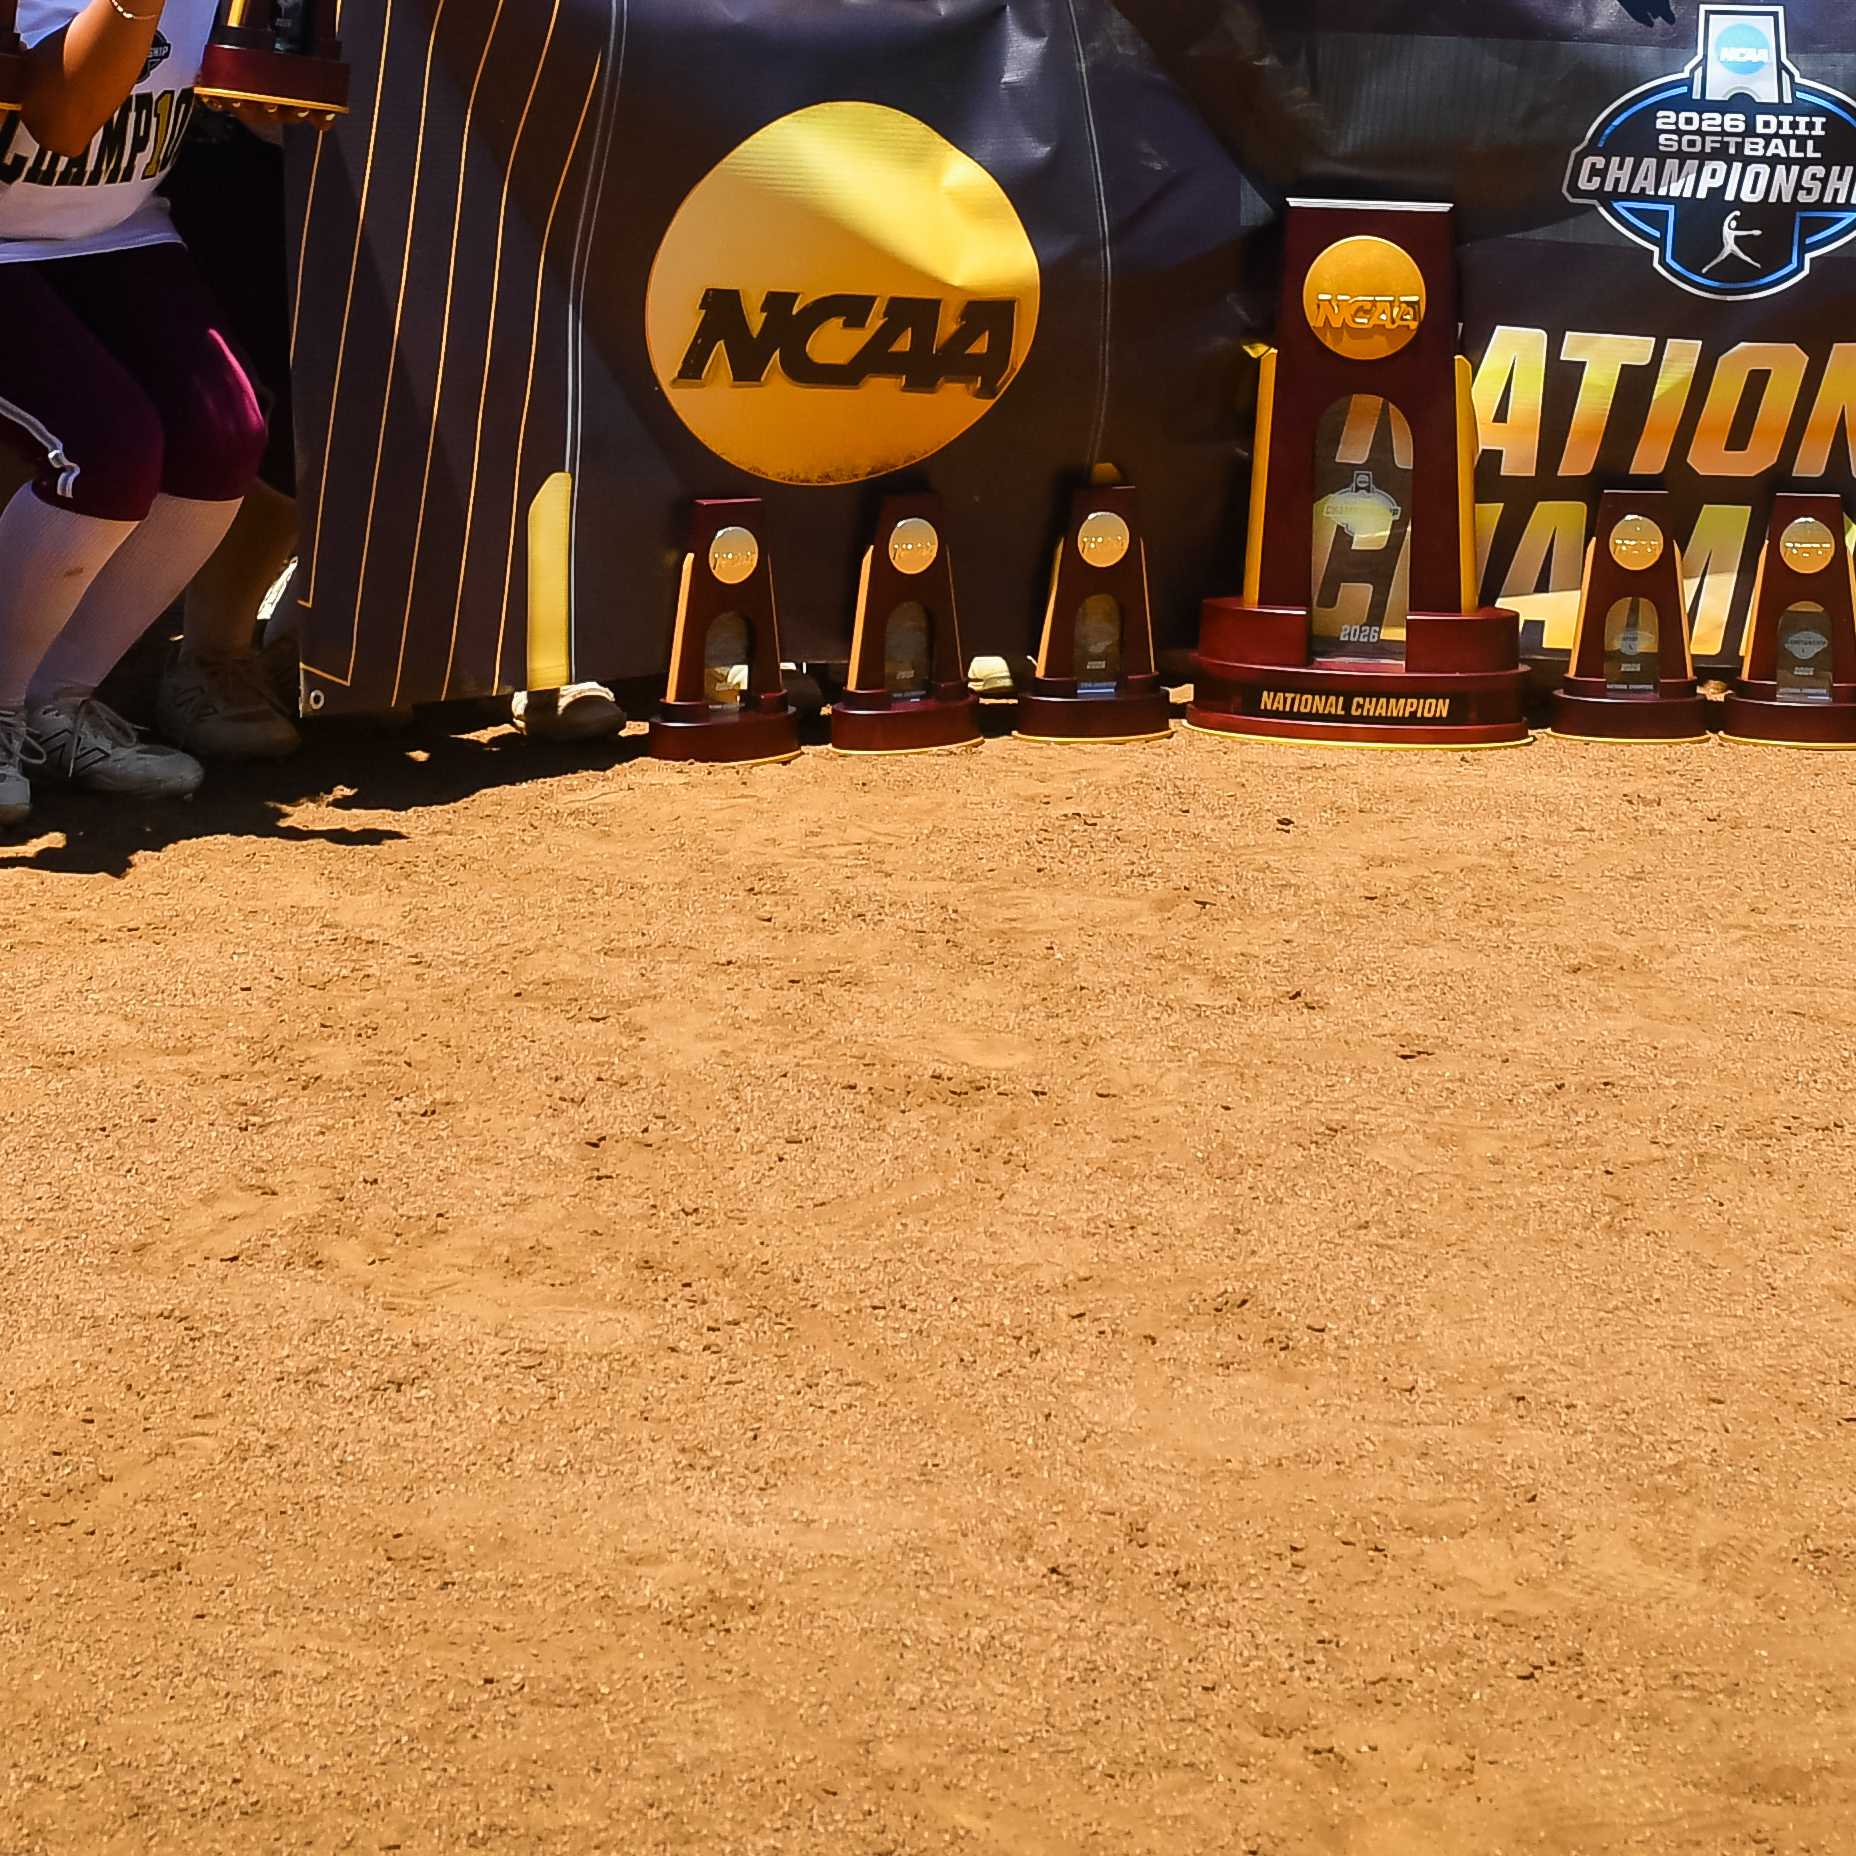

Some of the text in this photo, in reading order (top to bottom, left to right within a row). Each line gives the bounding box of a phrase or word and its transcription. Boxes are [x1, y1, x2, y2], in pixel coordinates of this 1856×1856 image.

[1719, 46, 1769, 63] NCAA
[1655, 110, 1827, 136] 2026 DIII
[1657, 134, 1822, 159] SOFTBALL
[1312, 292, 1421, 331] NCAA
[670, 288, 1021, 400] NCAA
[1339, 624, 1380, 643] 2026
[1259, 690, 1450, 719] NATIONAL CHAMPION
